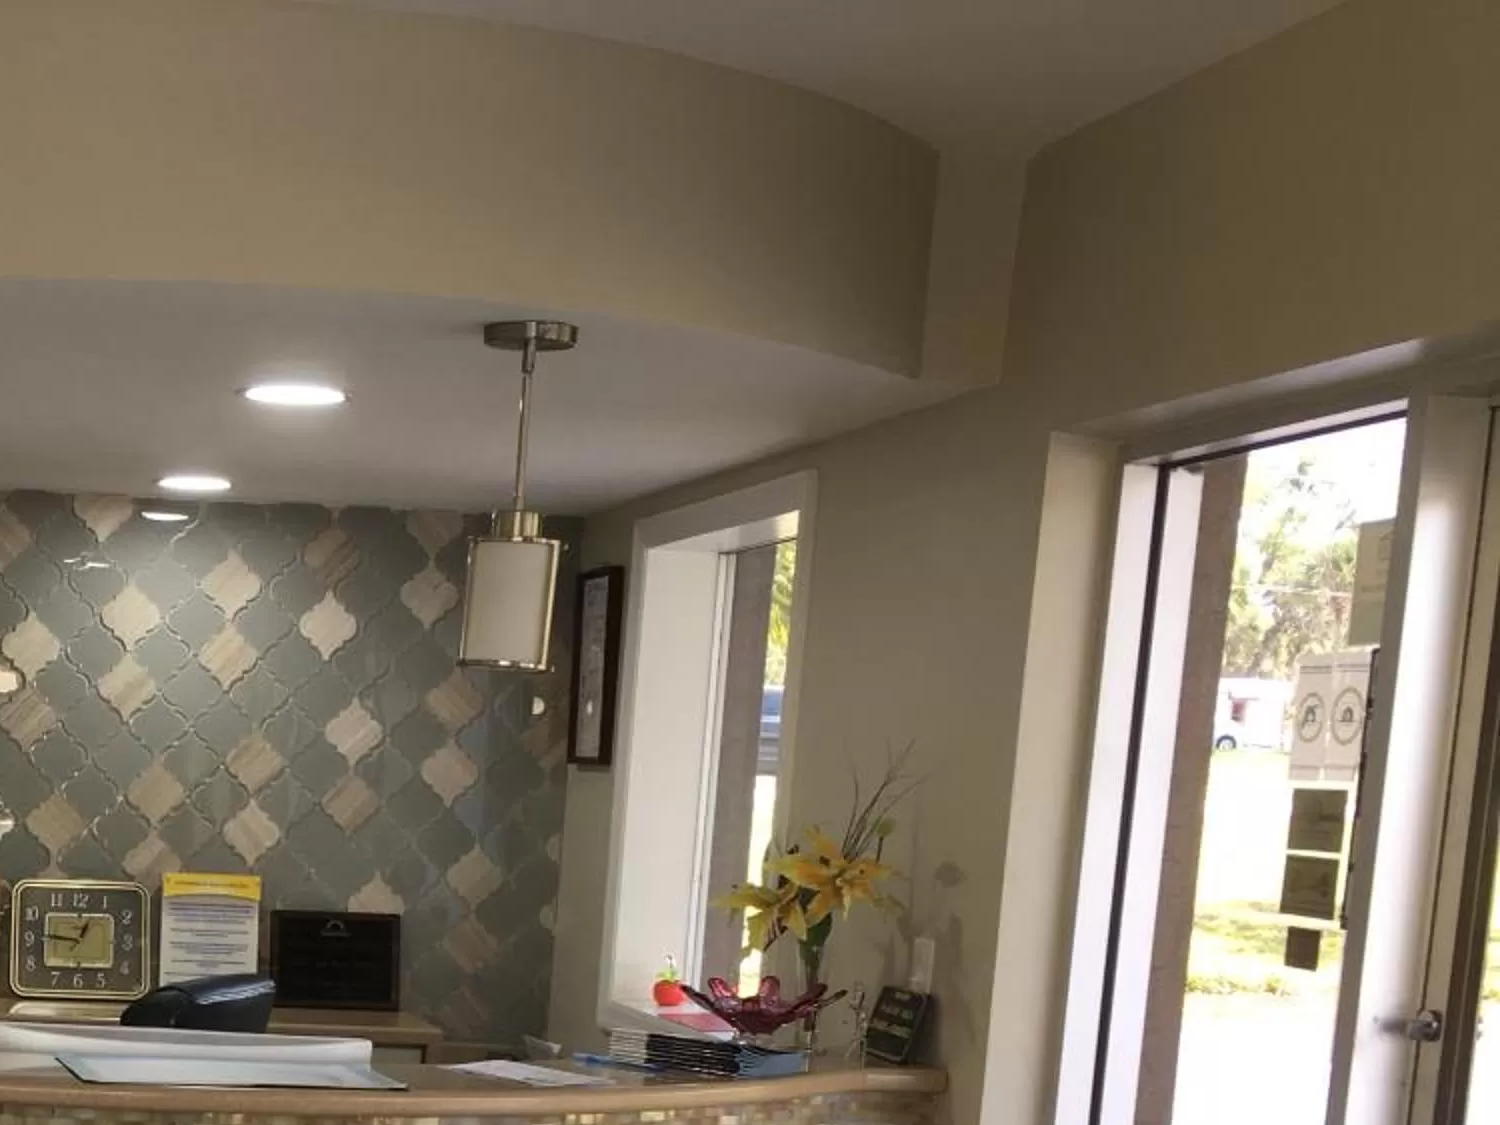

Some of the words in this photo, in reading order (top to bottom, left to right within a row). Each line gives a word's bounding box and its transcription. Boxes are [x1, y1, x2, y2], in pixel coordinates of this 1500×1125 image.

[51, 893, 63, 907] 11
[73, 892, 89, 909] 12
[102, 895, 109, 909] 1
[25, 905, 39, 921] 10
[121, 910, 133, 925] 2
[24, 930, 35, 947] 9
[122, 933, 133, 951] 3
[25, 955, 37, 973] 8
[119, 961, 130, 975] 4
[51, 971, 61, 987] 7
[73, 973, 84, 989] 6
[96, 972, 106, 988] 5
